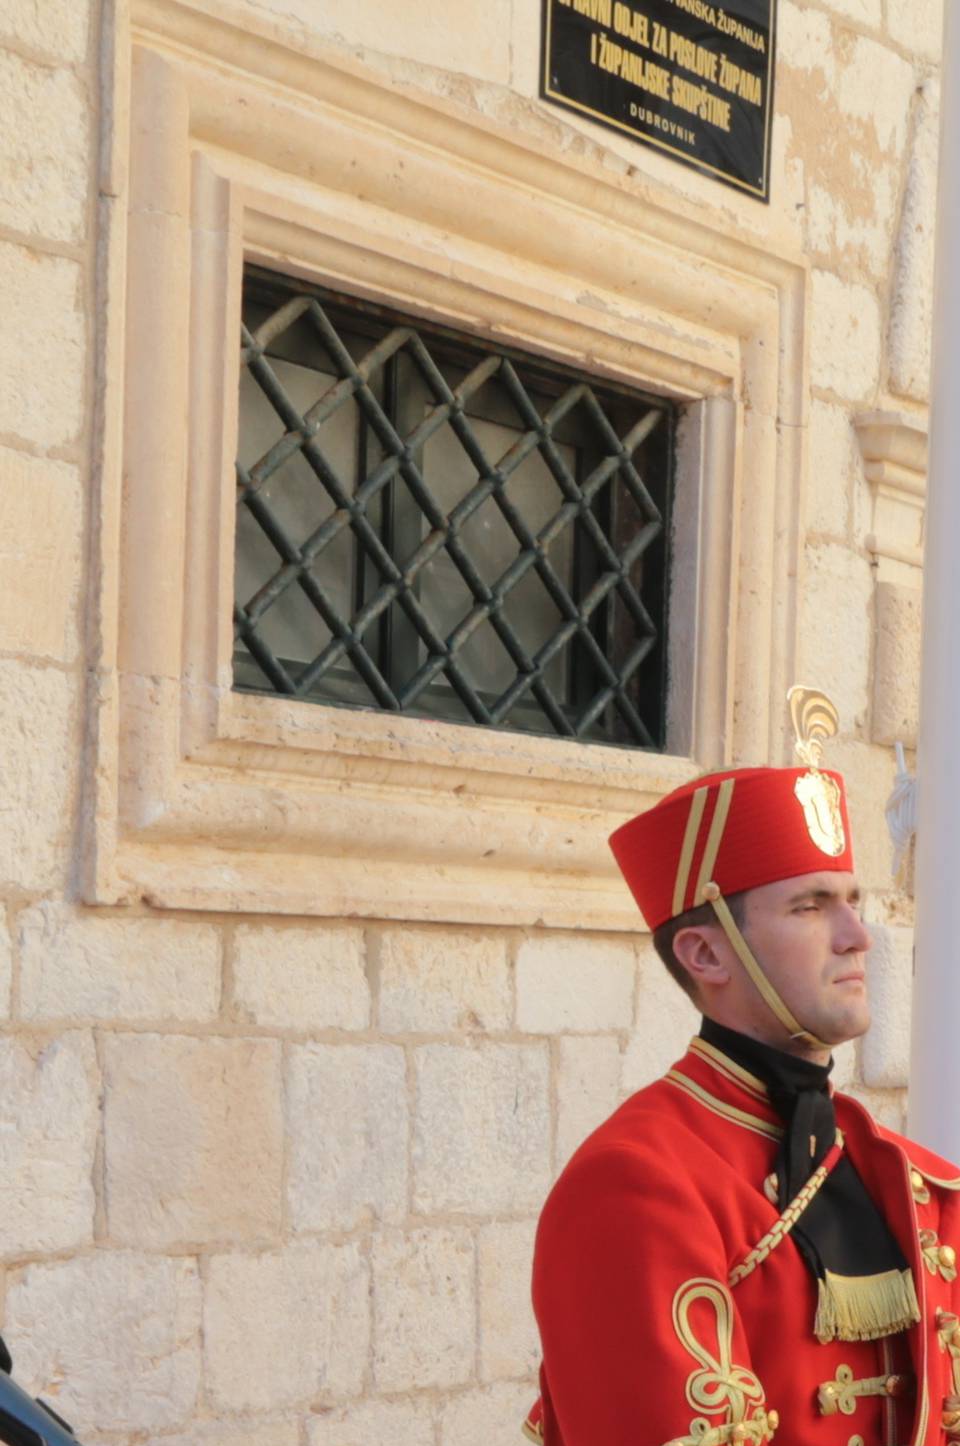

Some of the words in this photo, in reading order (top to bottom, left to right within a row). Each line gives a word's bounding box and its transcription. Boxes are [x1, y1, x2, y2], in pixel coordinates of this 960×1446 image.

[613, 1, 650, 48] ODJEL
[651, 21, 668, 57] ZA
[669, 31, 718, 84] POSLOVE
[718, 53, 762, 107] ŽUPANA
[717, 8, 765, 53] ŽUPANIJA
[590, 32, 597, 65] I
[598, 31, 670, 101] ŽUPANIJSKE
[672, 75, 731, 132] SKUPŠTINE
[630, 102, 696, 145] DUBROVNIK
